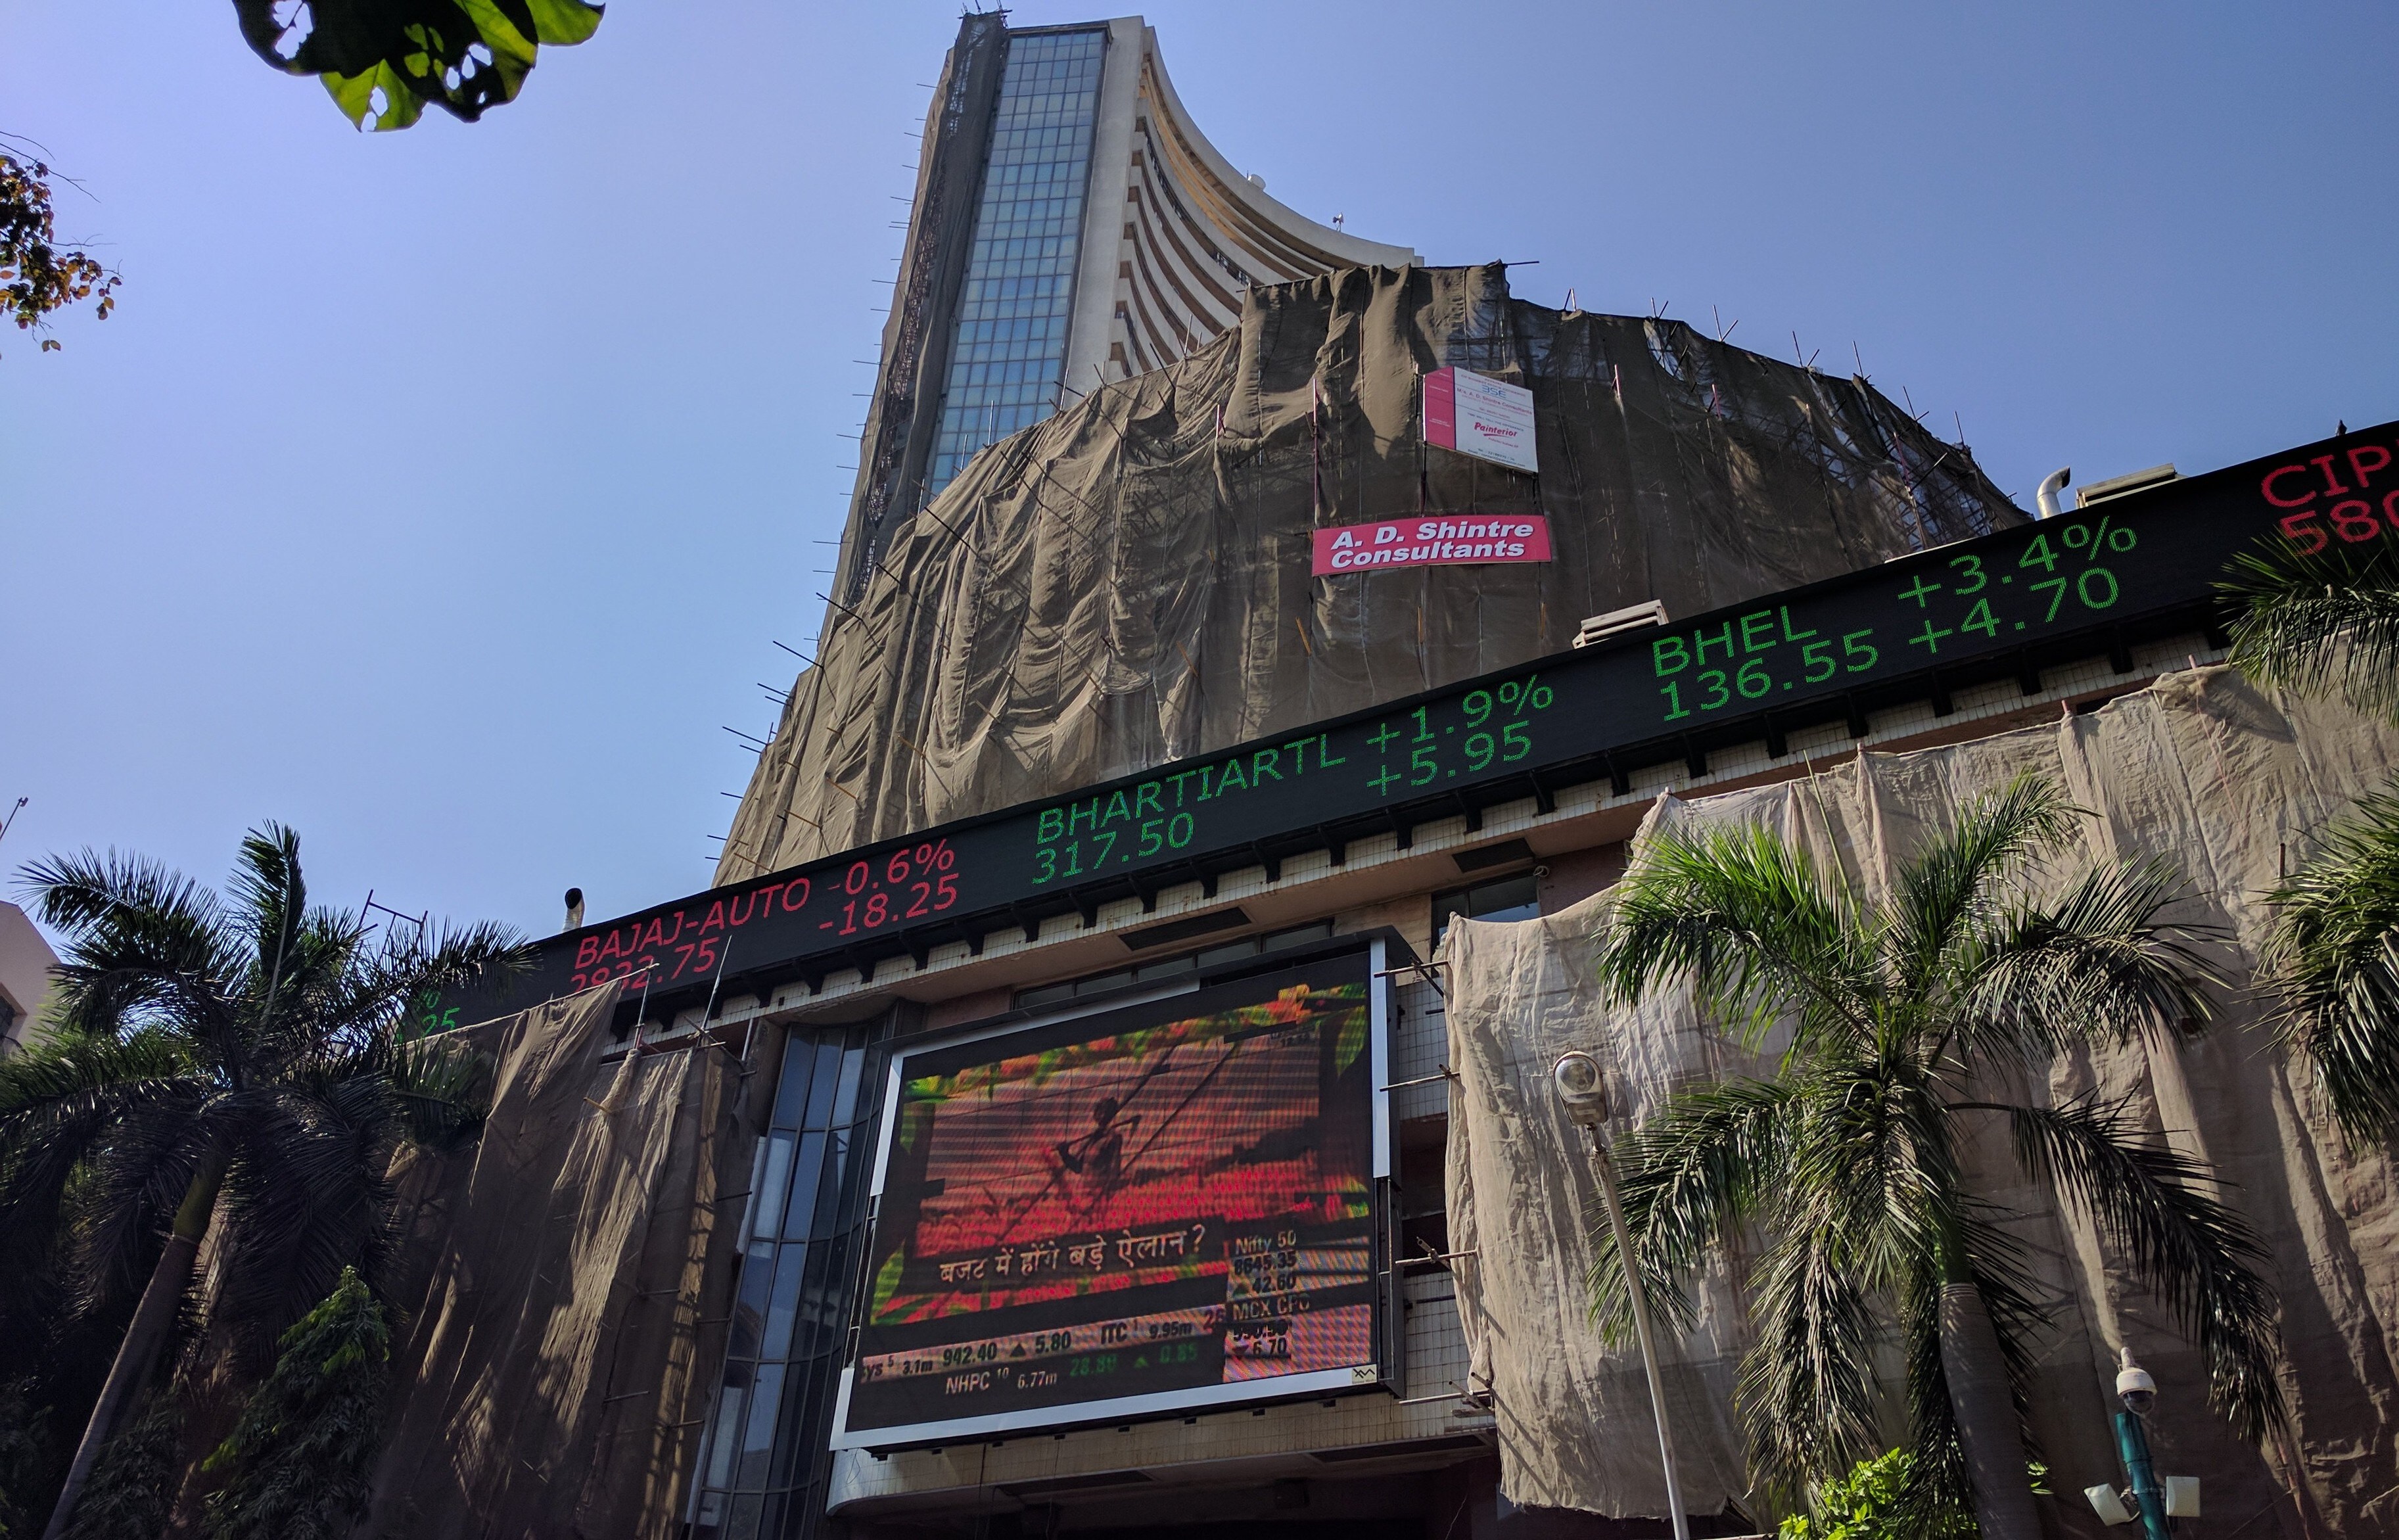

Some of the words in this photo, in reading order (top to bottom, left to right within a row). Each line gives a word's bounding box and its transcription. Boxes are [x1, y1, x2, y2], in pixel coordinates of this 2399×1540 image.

[1474, 422, 1518, 437] Painterior
[2261, 439, 2399, 507] CIP
[1330, 531, 1363, 550] A.
[1374, 526, 1404, 545] D.
[1416, 521, 1533, 540] Shintre
[1331, 540, 1525, 569] Consultants
[1652, 605, 1817, 677] BHEL
[1898, 516, 2137, 608] +3.4%
[1661, 628, 1880, 721] 136.55
[1909, 567, 2120, 654] +4.70
[1036, 734, 1346, 846] BHARTIARTL
[1366, 674, 1554, 754] +1.9%
[1032, 813, 1194, 885] 317.50
[1366, 720, 1532, 797] +5.95
[574, 877, 810, 970] BAJAJ-AUTO
[827, 838, 955, 895] -0.6%
[818, 873, 961, 936] -18.25
[939, 1257, 988, 1283] बजट
[994, 1248, 1015, 1276] में
[1020, 1240, 1060, 1276] होंगे
[1069, 1234, 1107, 1272] बड़े
[1234, 1249, 1297, 1276] 8645.35
[1235, 1234, 1272, 1255] Nifty
[1277, 1229, 1296, 1248] 50
[902, 1359, 933, 1375] 3.1m
[943, 1342, 998, 1366] 942.40
[1035, 1330, 1072, 1354] 5.80
[1100, 1322, 1128, 1345] ITC
[1149, 1320, 1193, 1339] 9.95m
[945, 1371, 991, 1395] NHPC
[997, 1366, 1010, 1380] 10
[1017, 1371, 1058, 1389] 6.77m
